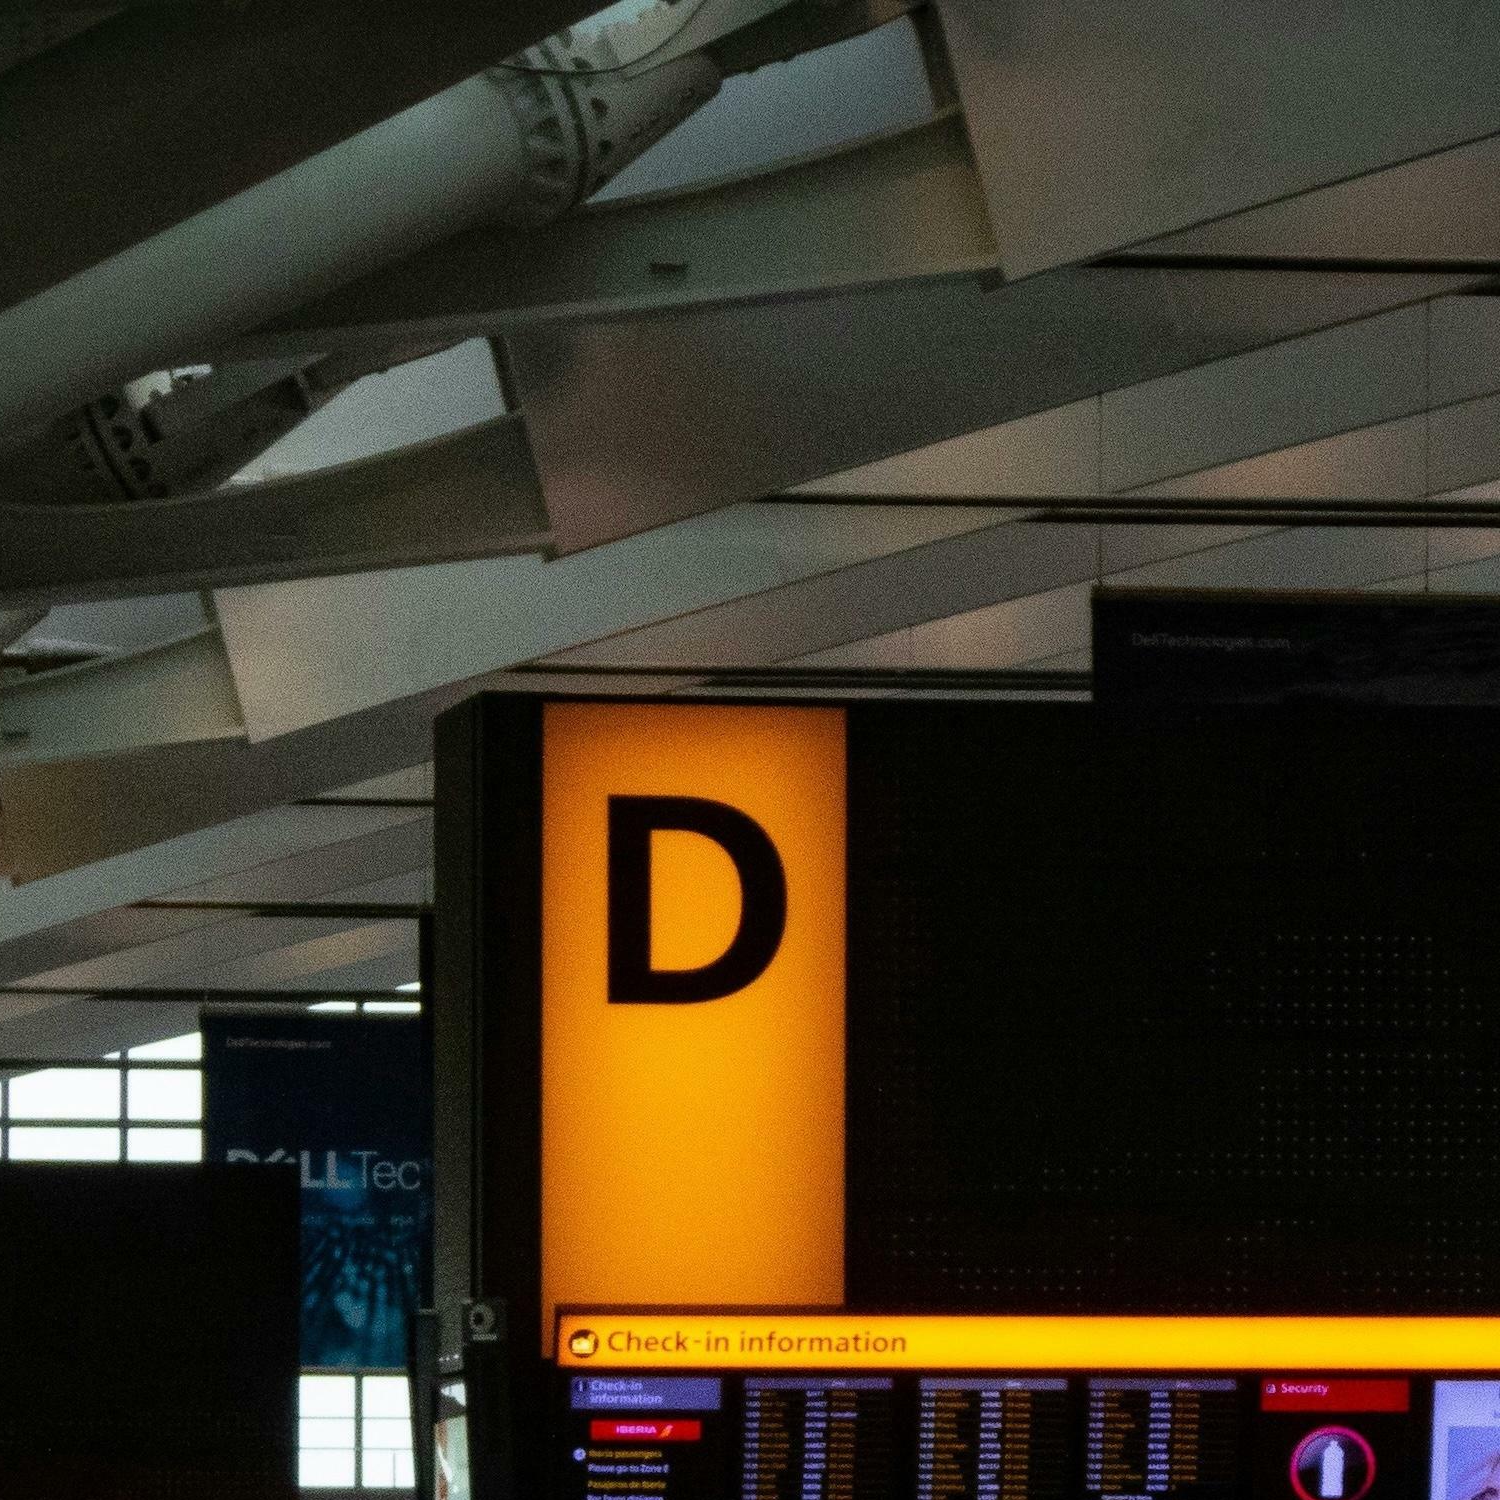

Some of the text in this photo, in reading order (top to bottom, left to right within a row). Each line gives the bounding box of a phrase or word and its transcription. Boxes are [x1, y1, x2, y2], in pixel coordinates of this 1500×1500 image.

[607, 794, 788, 1004] D
[607, 1330, 907, 1353] Check-in information
[589, 1380, 644, 1391] Check-in
[1280, 1383, 1329, 1396] Security
[589, 1393, 663, 1404] information
[615, 1425, 658, 1435] IBERIA
